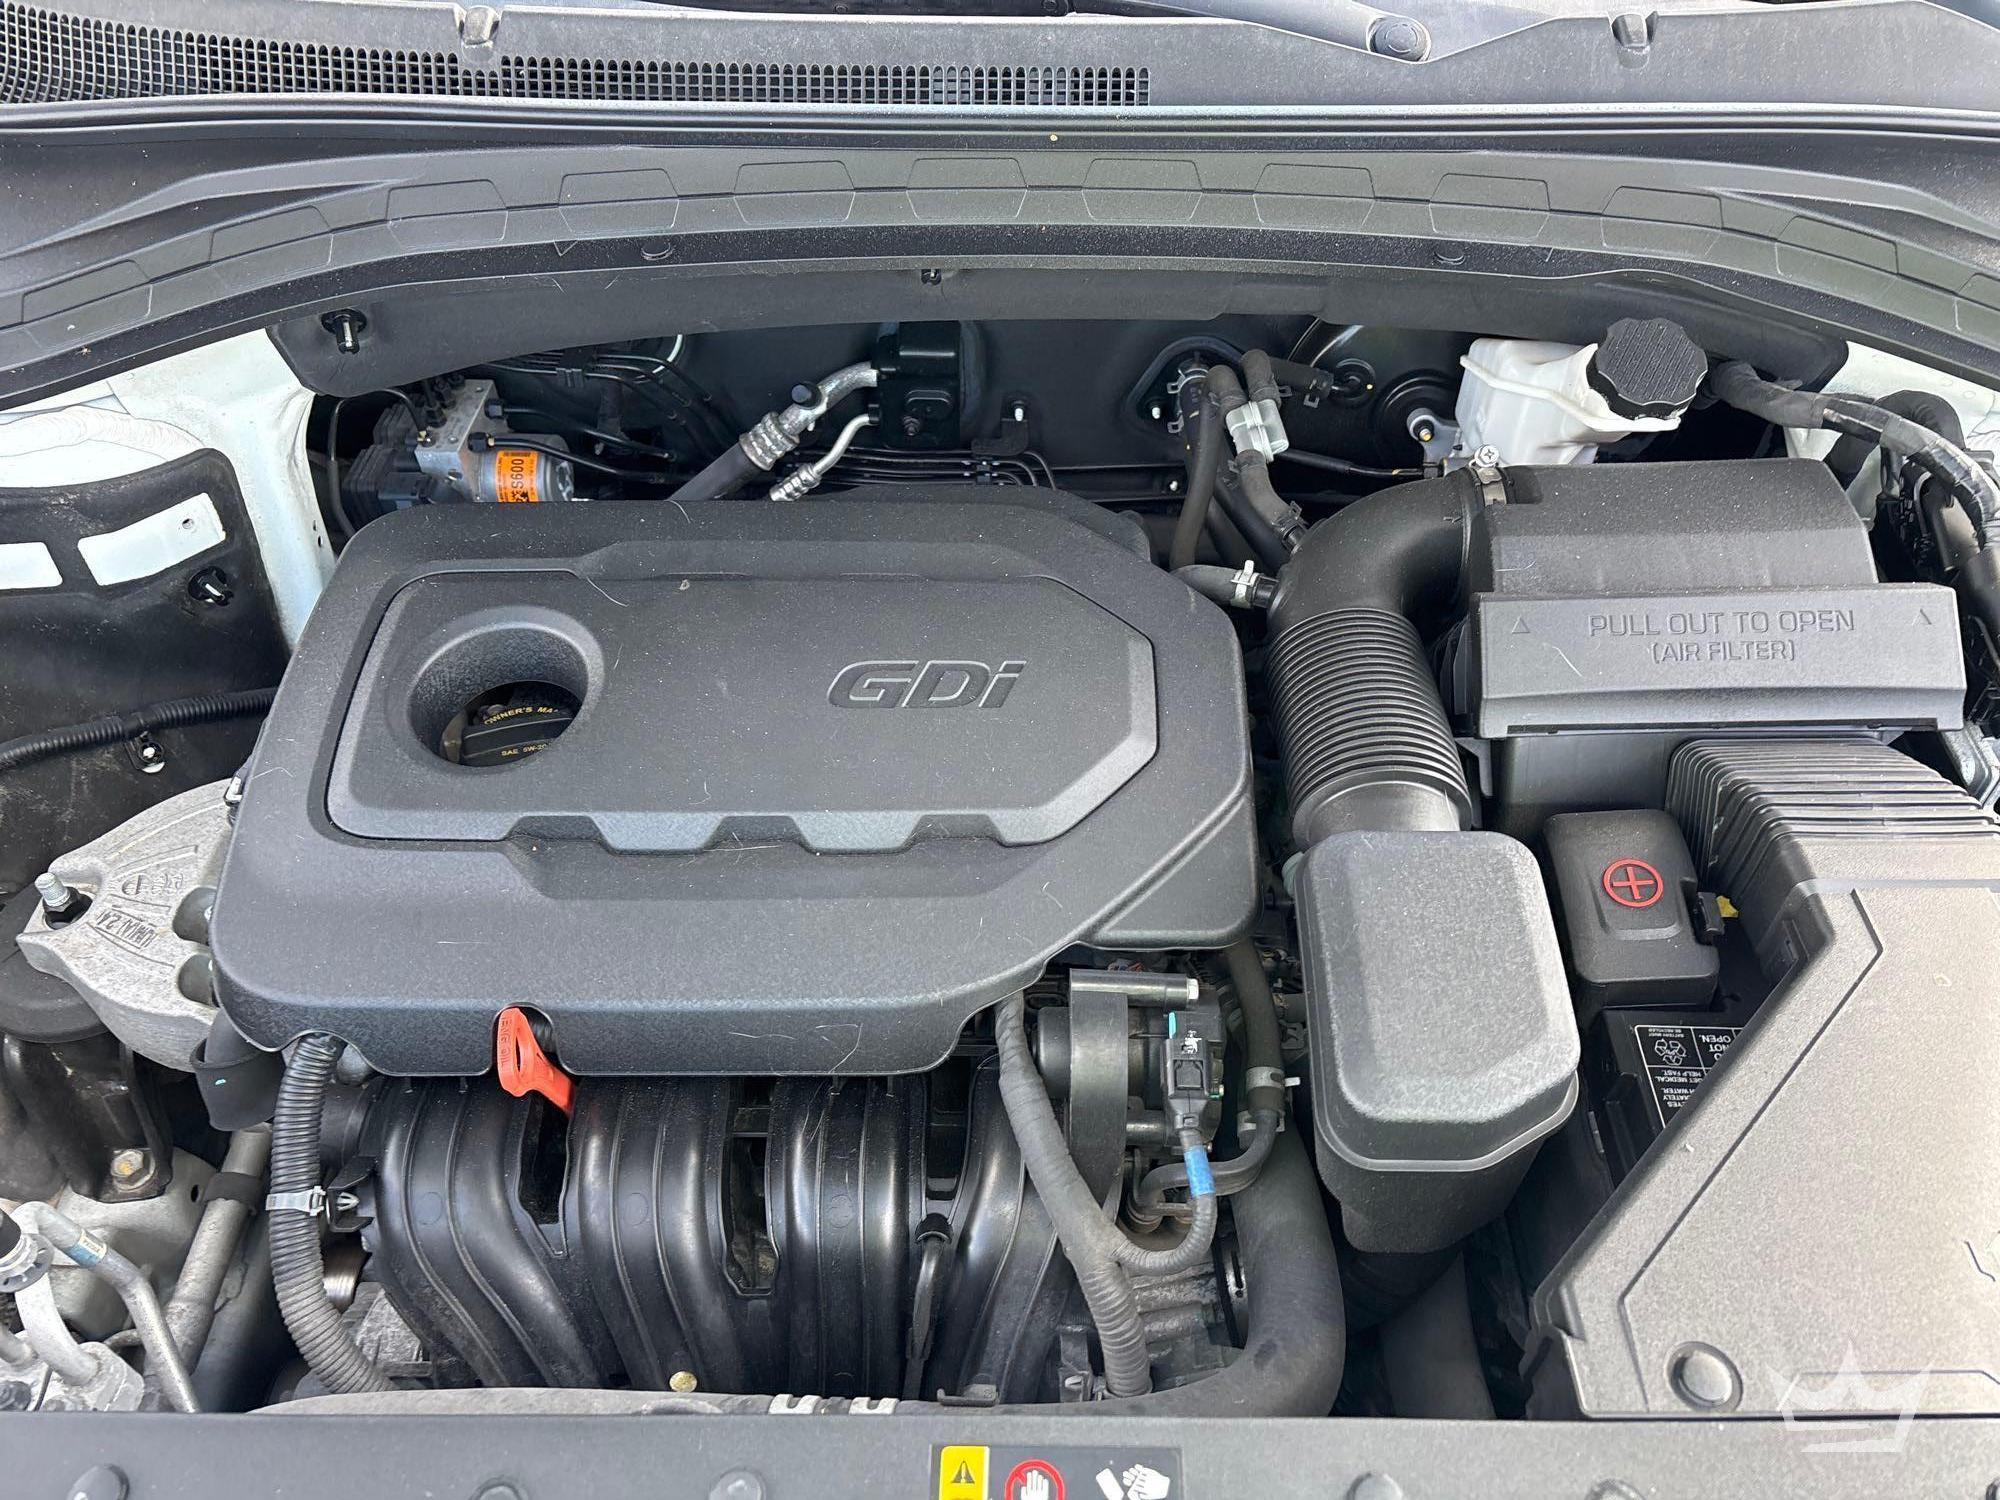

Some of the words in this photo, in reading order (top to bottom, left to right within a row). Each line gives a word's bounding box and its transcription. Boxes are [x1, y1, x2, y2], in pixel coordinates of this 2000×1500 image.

[511, 458, 524, 489] S600
[1588, 613, 1660, 636] PULL
[1667, 612, 1724, 635] OUT
[1732, 611, 1768, 633] TO
[1778, 610, 1854, 632] OPEN
[1651, 642, 1700, 664] (AIR
[1706, 640, 1795, 661] FILTER)
[827, 660, 1027, 708] GDi
[484, 706, 533, 725] OWNER'S
[501, 748, 519, 756] SAE
[1698, 1034, 1731, 1043] OPEN.
